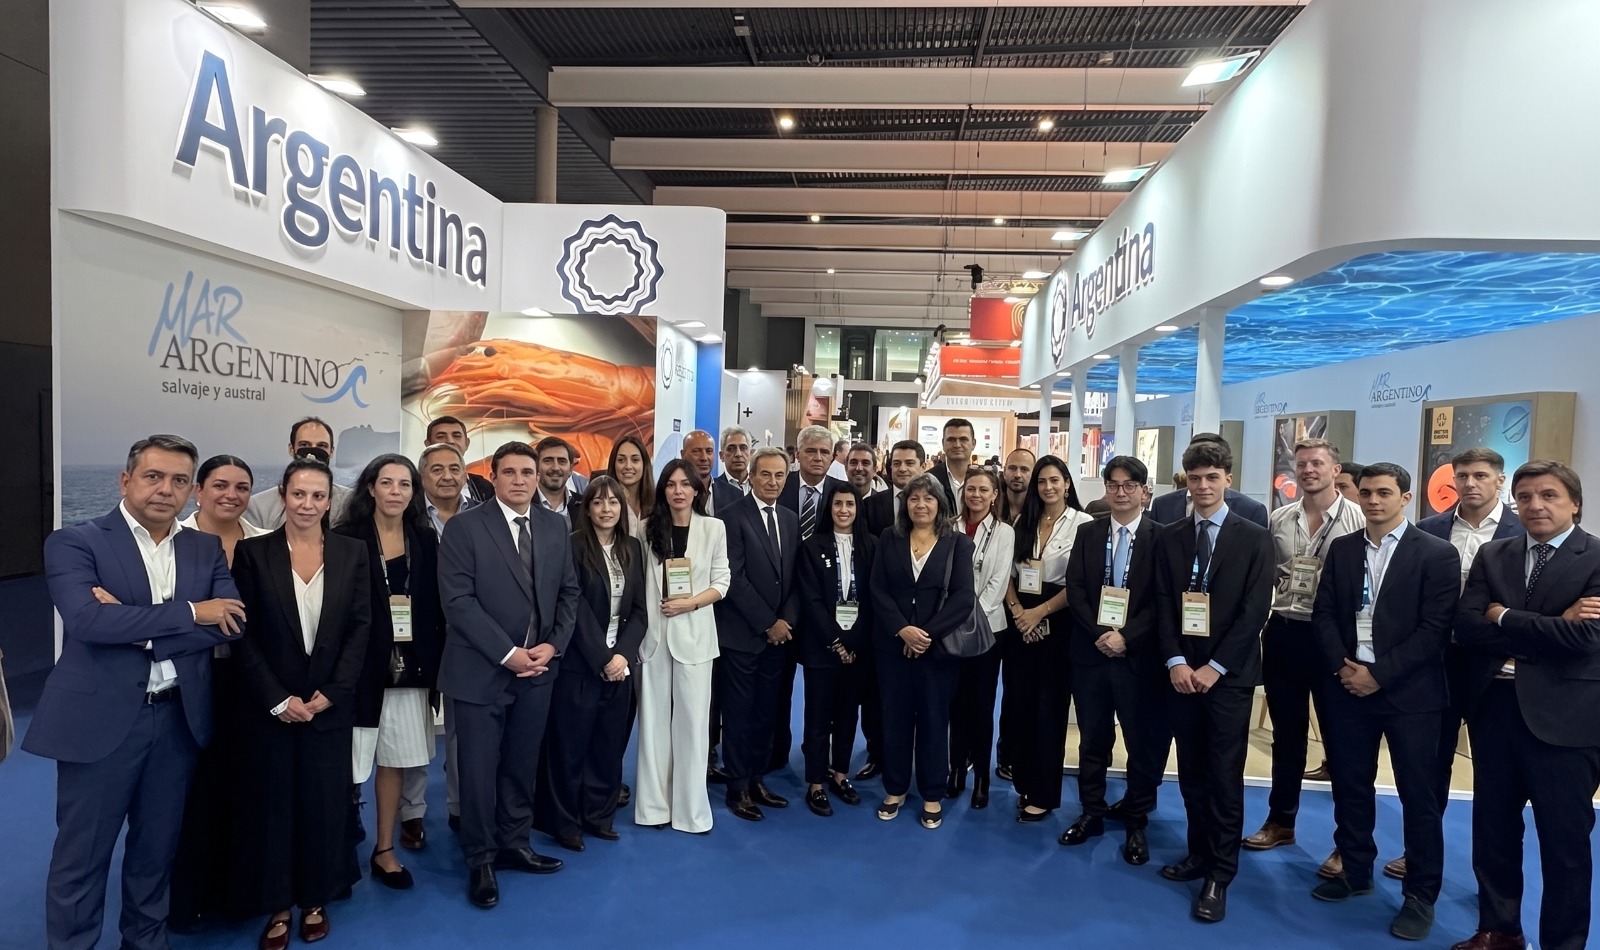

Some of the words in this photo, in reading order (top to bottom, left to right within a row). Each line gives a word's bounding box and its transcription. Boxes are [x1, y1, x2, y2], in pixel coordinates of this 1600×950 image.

[174, 49, 488, 288] Argentina
[148, 270, 247, 356] MAR
[1071, 222, 1154, 338] Argentina
[160, 334, 339, 389] ARGENTINO
[162, 378, 210, 400] salvaje
[213, 387, 221, 401] y
[224, 387, 266, 401] austral
[1371, 385, 1423, 402] ARGENTINO
